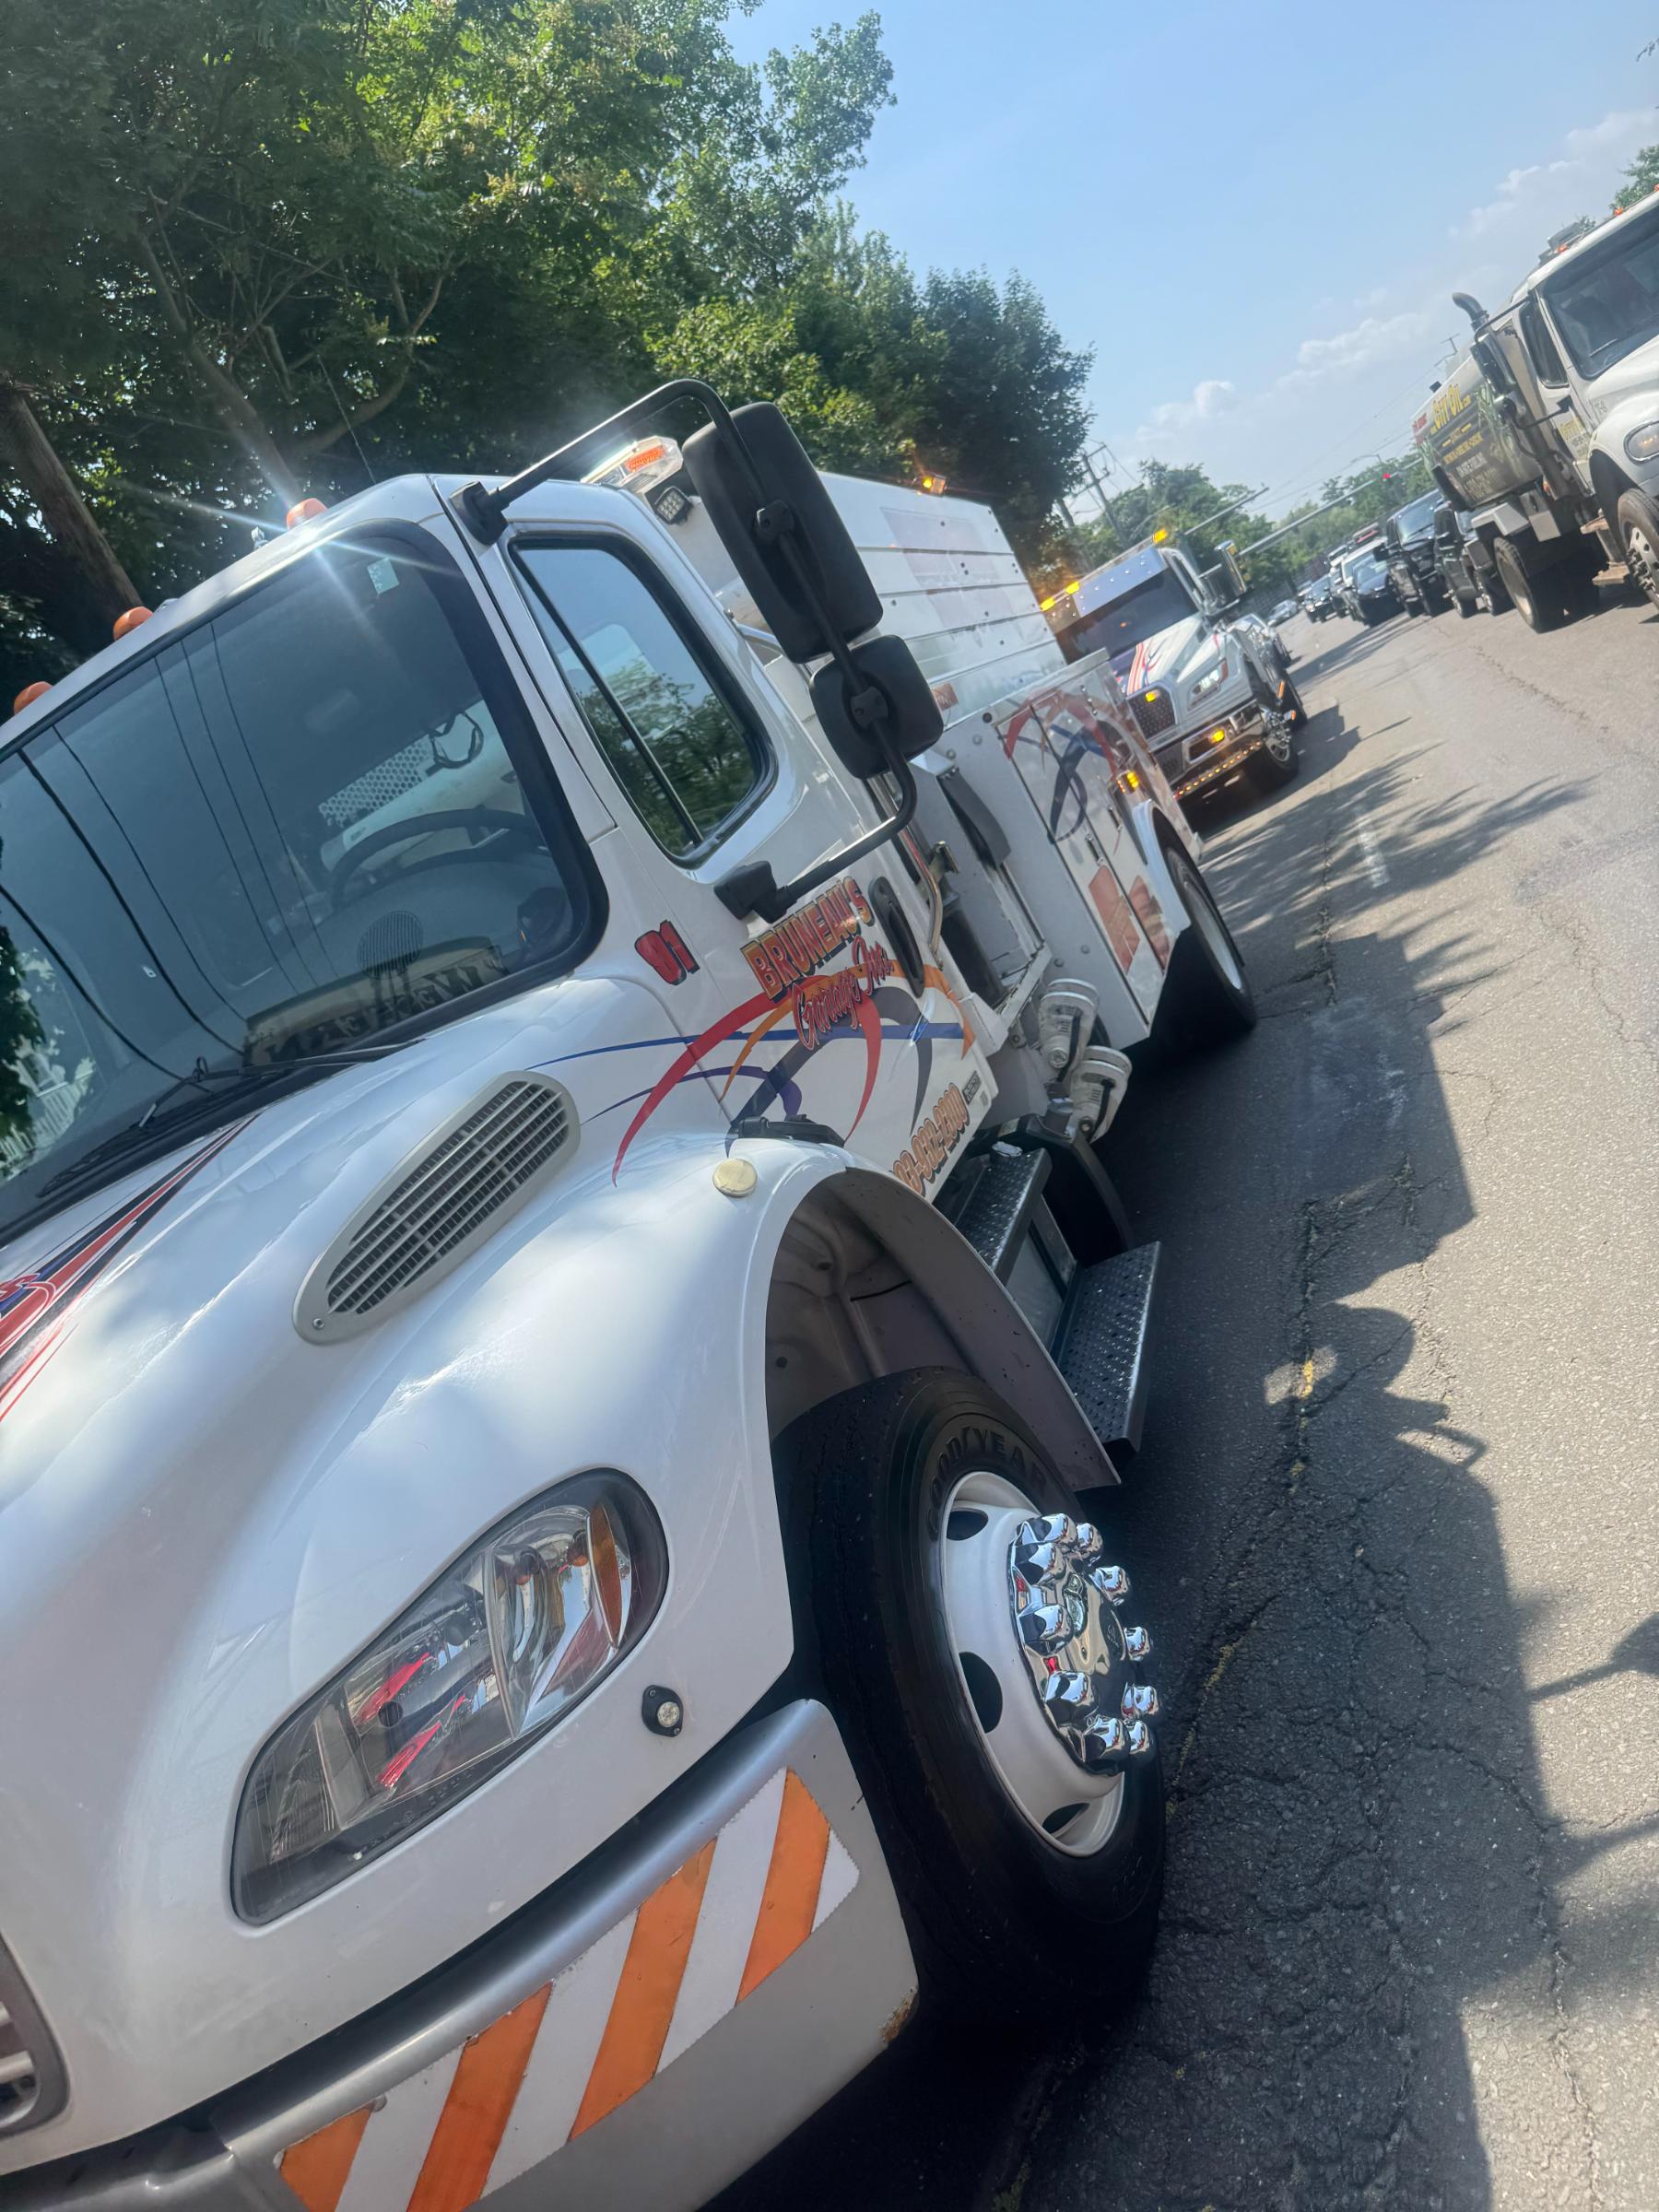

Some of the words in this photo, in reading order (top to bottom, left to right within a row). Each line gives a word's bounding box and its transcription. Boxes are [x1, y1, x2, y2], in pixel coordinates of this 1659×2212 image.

[740, 877, 875, 1003] BRUNEAU'S
[793, 966, 863, 1051] Garage
[889, 1082, 970, 1198] 03-932-2300
[927, 1426, 1048, 1543] GOODYEAR
